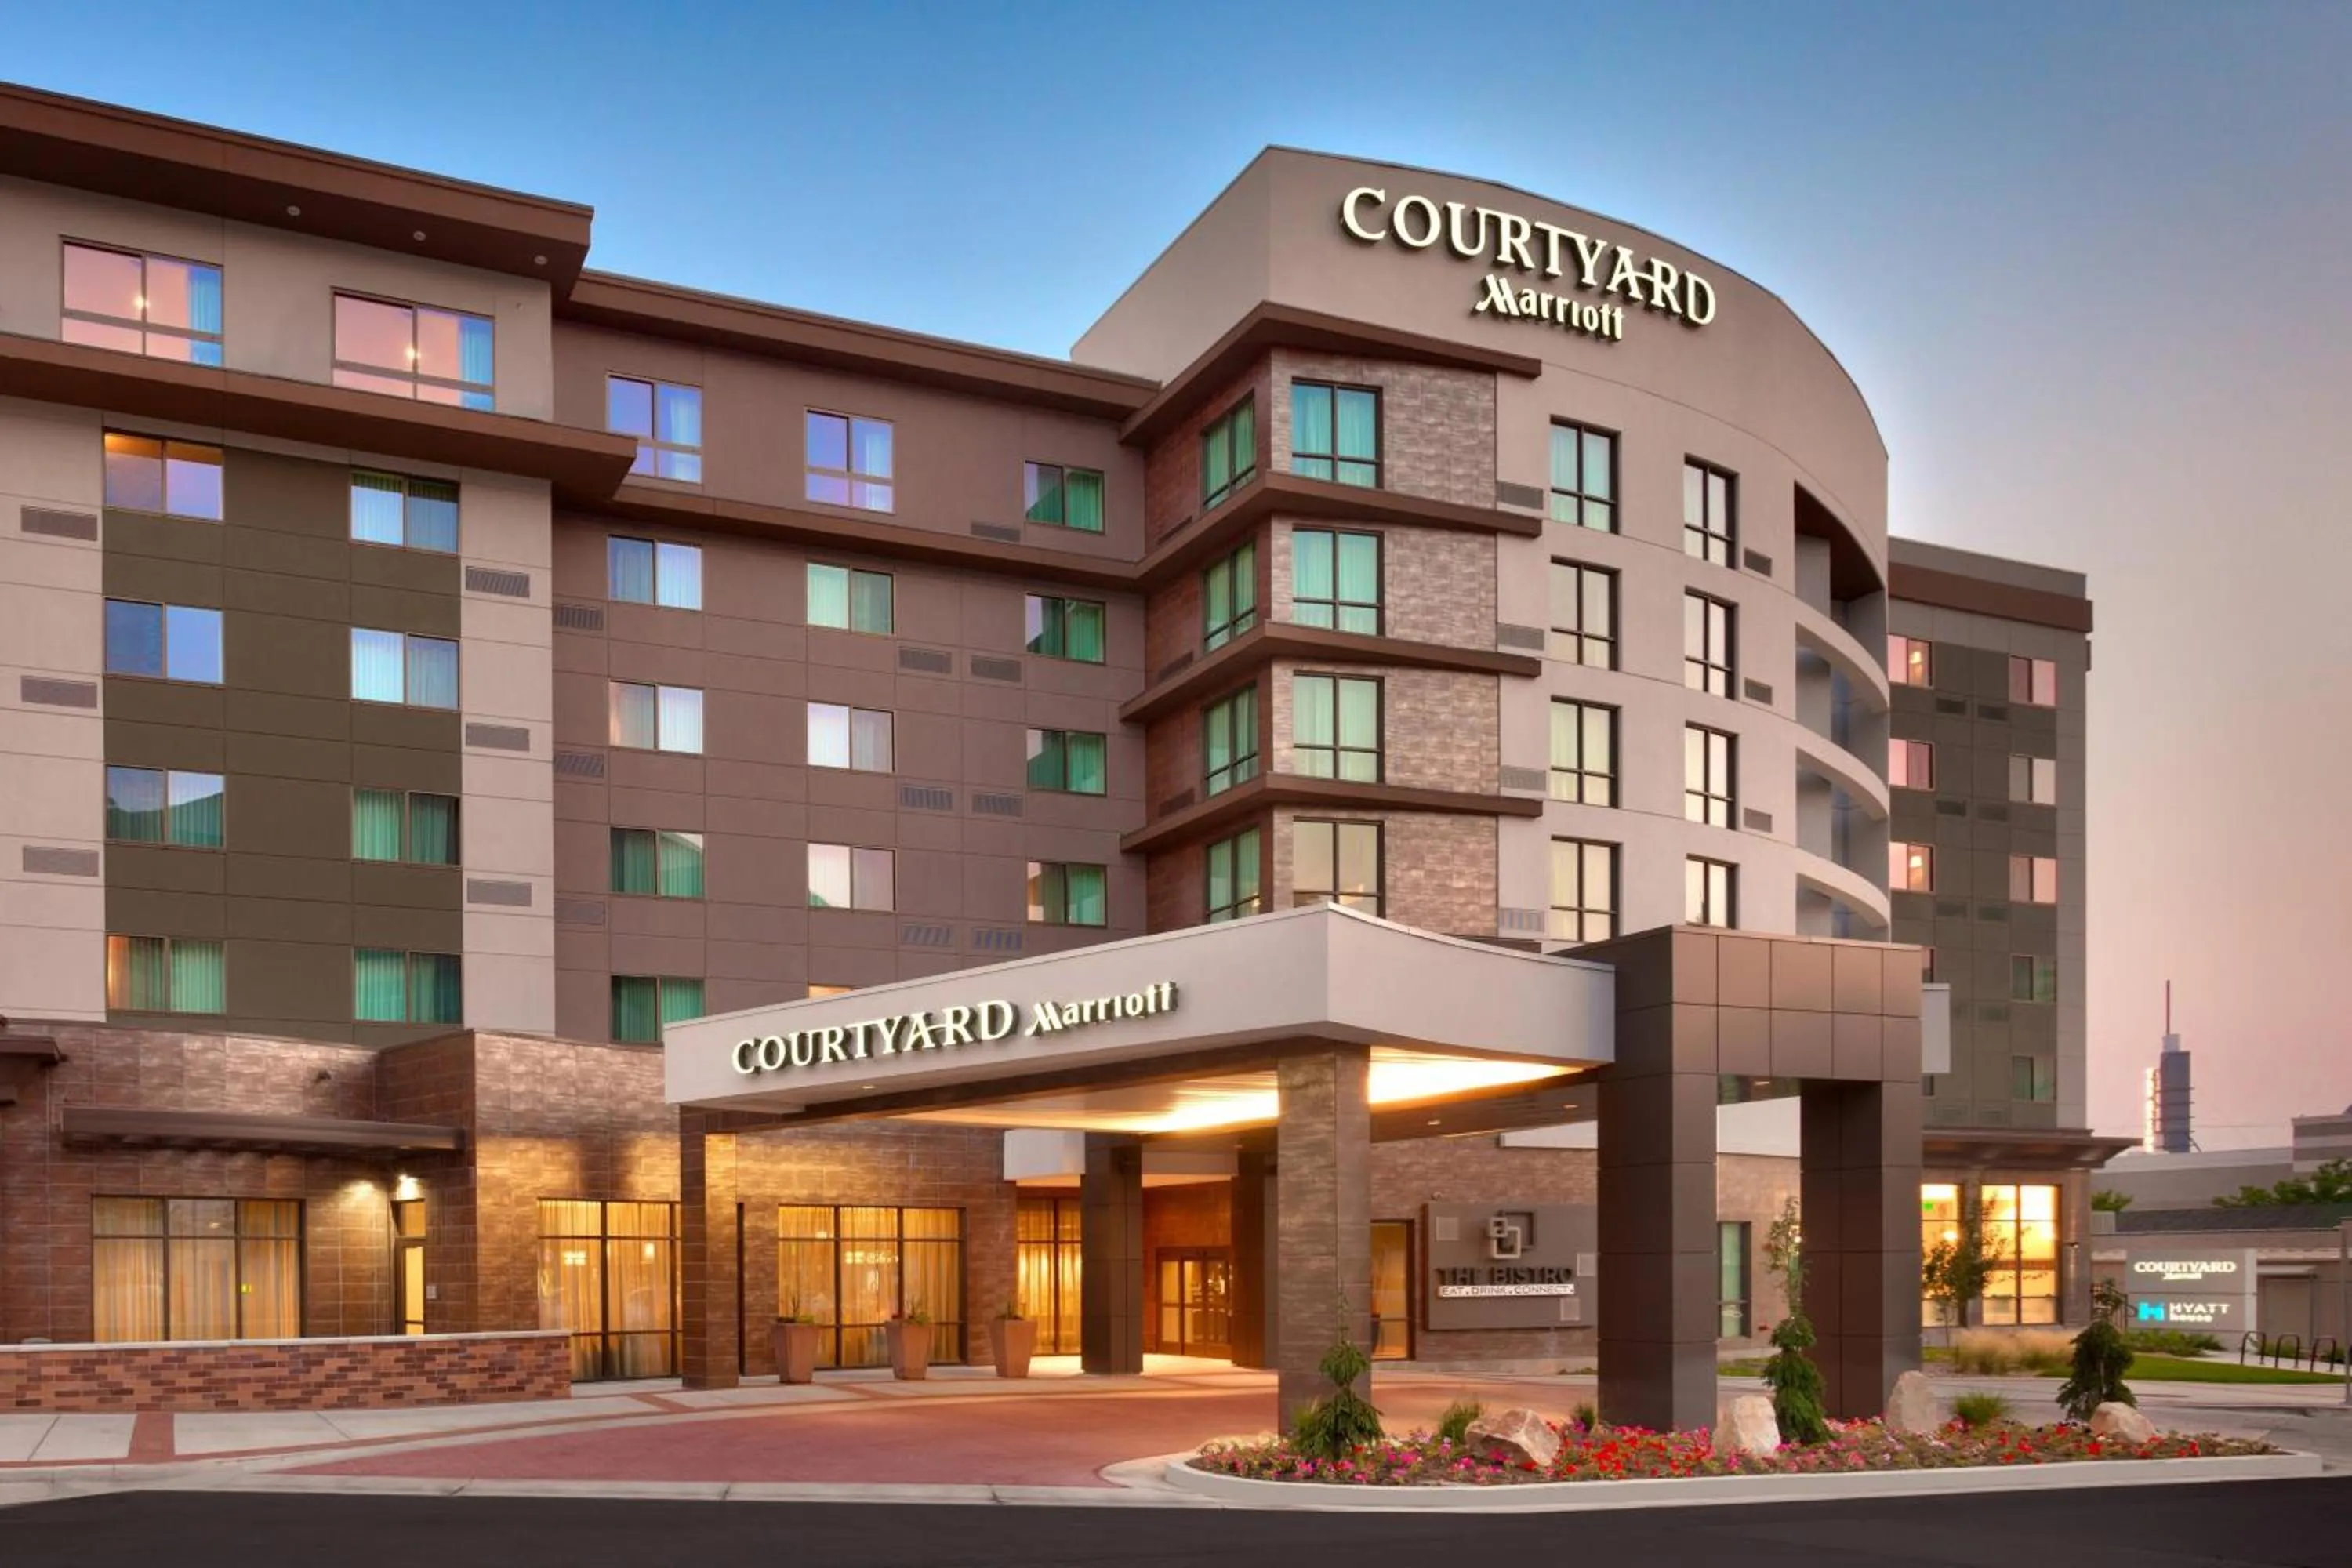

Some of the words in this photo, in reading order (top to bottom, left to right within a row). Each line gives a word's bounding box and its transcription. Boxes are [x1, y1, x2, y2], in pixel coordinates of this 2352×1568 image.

[1341, 187, 1716, 327] COURTYARD
[1475, 274, 1623, 340] Marriott
[731, 1000, 1016, 1074] COURTYARD
[1025, 981, 1177, 1036] Marriott
[2134, 1261, 2237, 1273] COURTYARD
[2169, 1302, 2230, 1314] HYATT
